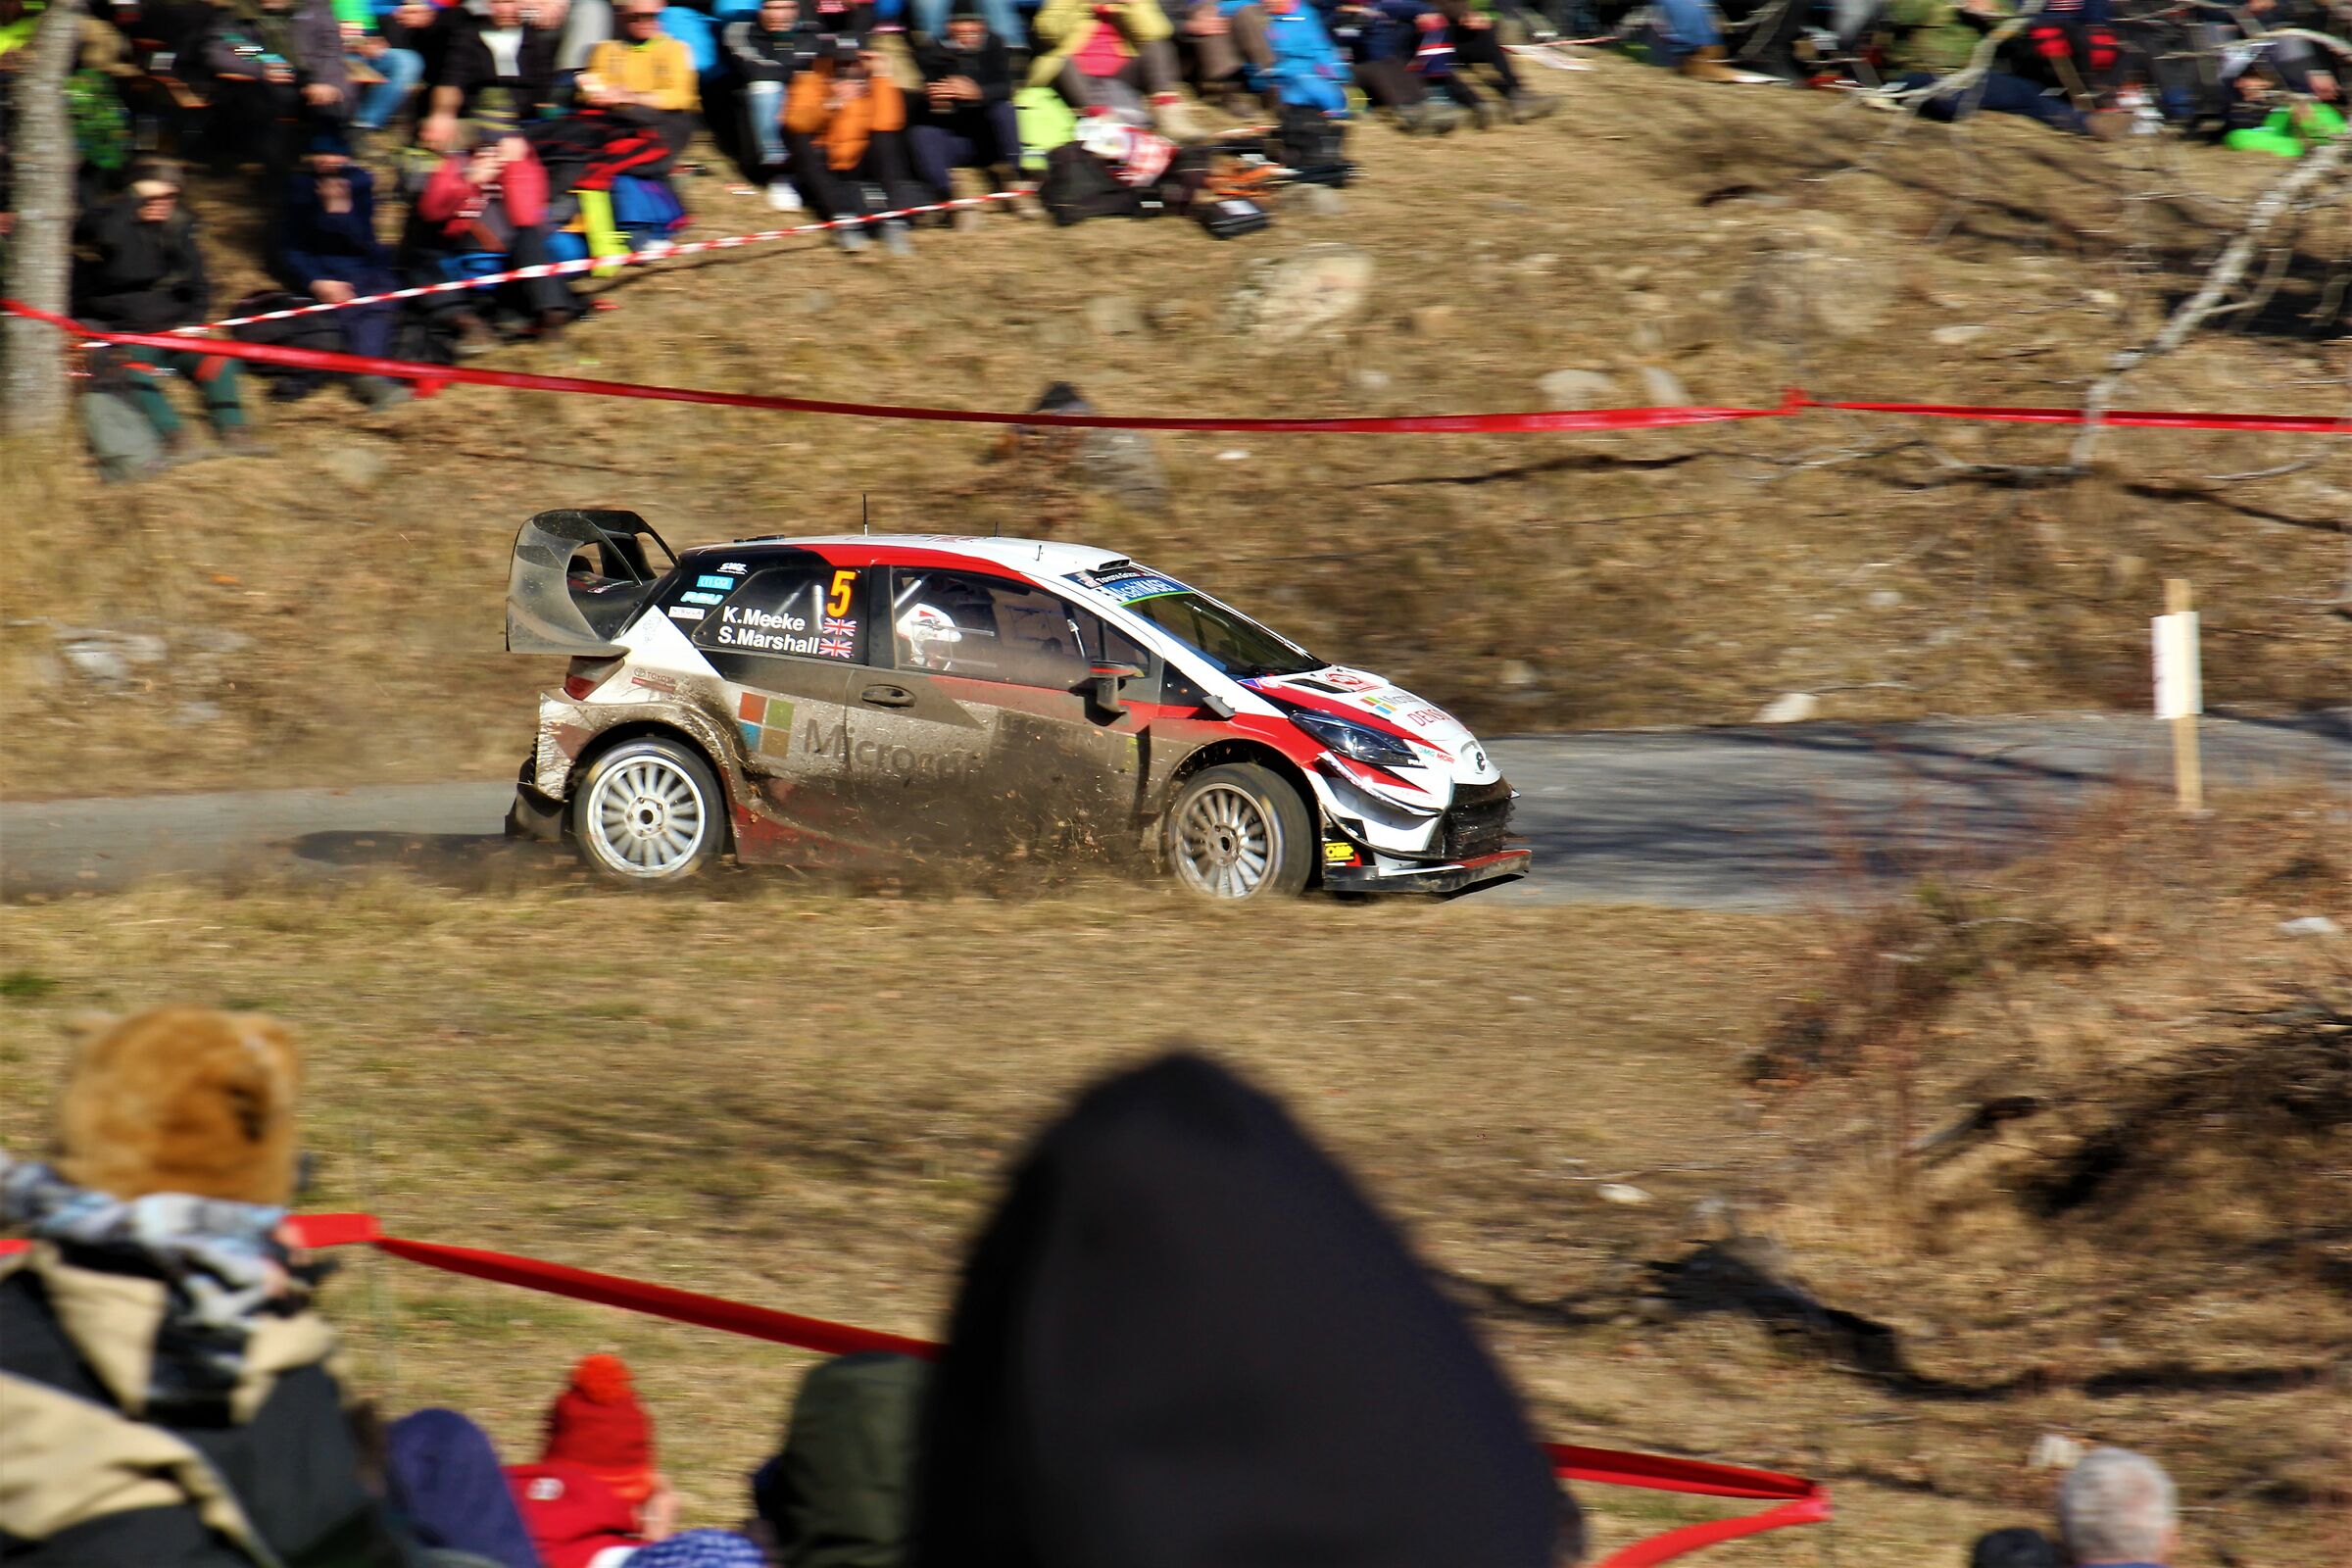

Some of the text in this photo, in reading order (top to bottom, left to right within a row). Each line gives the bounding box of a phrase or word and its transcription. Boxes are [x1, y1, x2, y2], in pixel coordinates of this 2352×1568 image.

[826, 569, 857, 617] 5
[721, 606, 806, 632] K.Meeke
[717, 625, 819, 655] S.Marshall
[804, 718, 984, 777] Micro
[1325, 845, 1354, 858] OMP
